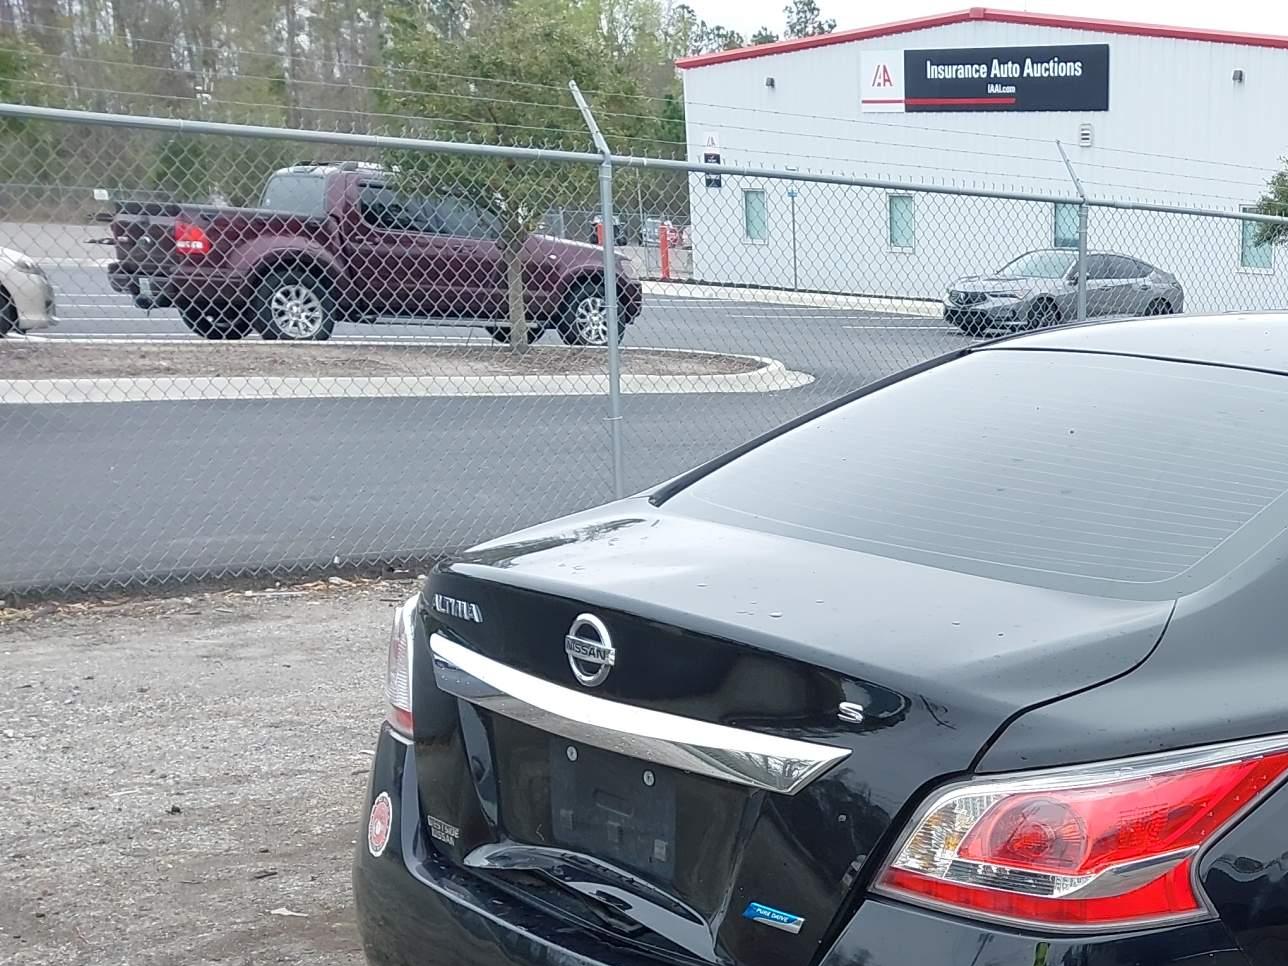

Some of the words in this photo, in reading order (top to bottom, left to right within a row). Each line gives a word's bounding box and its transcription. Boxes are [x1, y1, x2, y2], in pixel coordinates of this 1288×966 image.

[926, 60, 988, 79] Insurance
[990, 59, 1020, 78] Auto
[1023, 57, 1082, 77] Auctions
[567, 639, 607, 661] NISSAN
[837, 701, 864, 724] S
[756, 908, 771, 917] PURE
[771, 912, 789, 923] DRIVE
